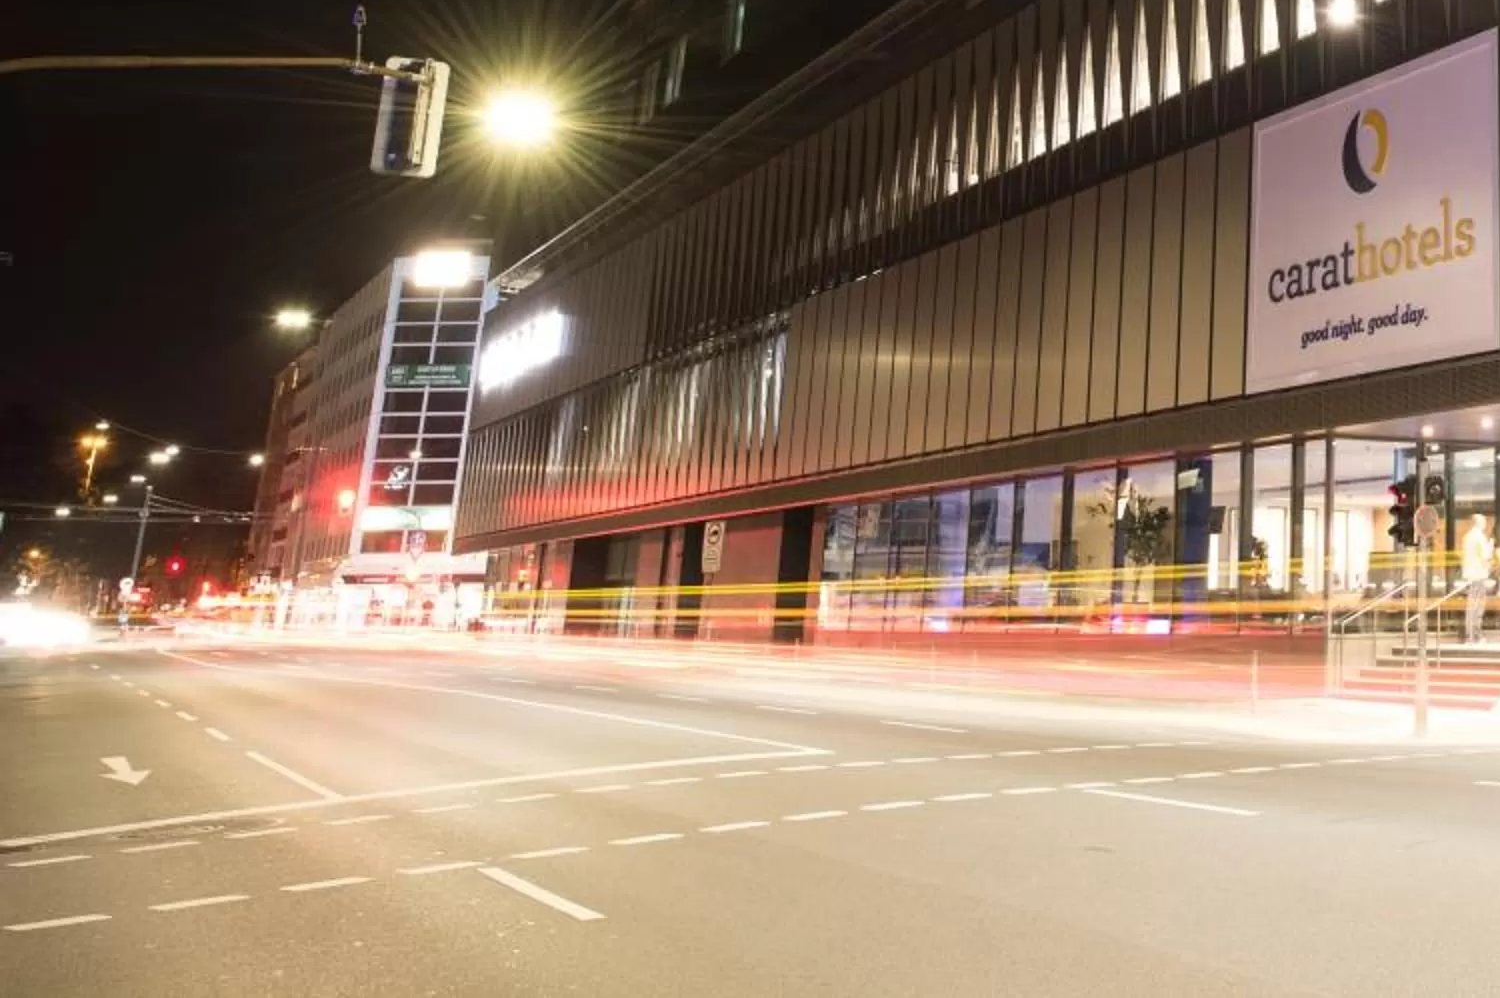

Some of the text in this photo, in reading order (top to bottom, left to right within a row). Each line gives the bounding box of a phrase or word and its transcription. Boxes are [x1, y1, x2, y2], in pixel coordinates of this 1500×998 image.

[1268, 198, 1475, 303] carathotels
[1301, 319, 1329, 349] good
[1367, 304, 1399, 335] good
